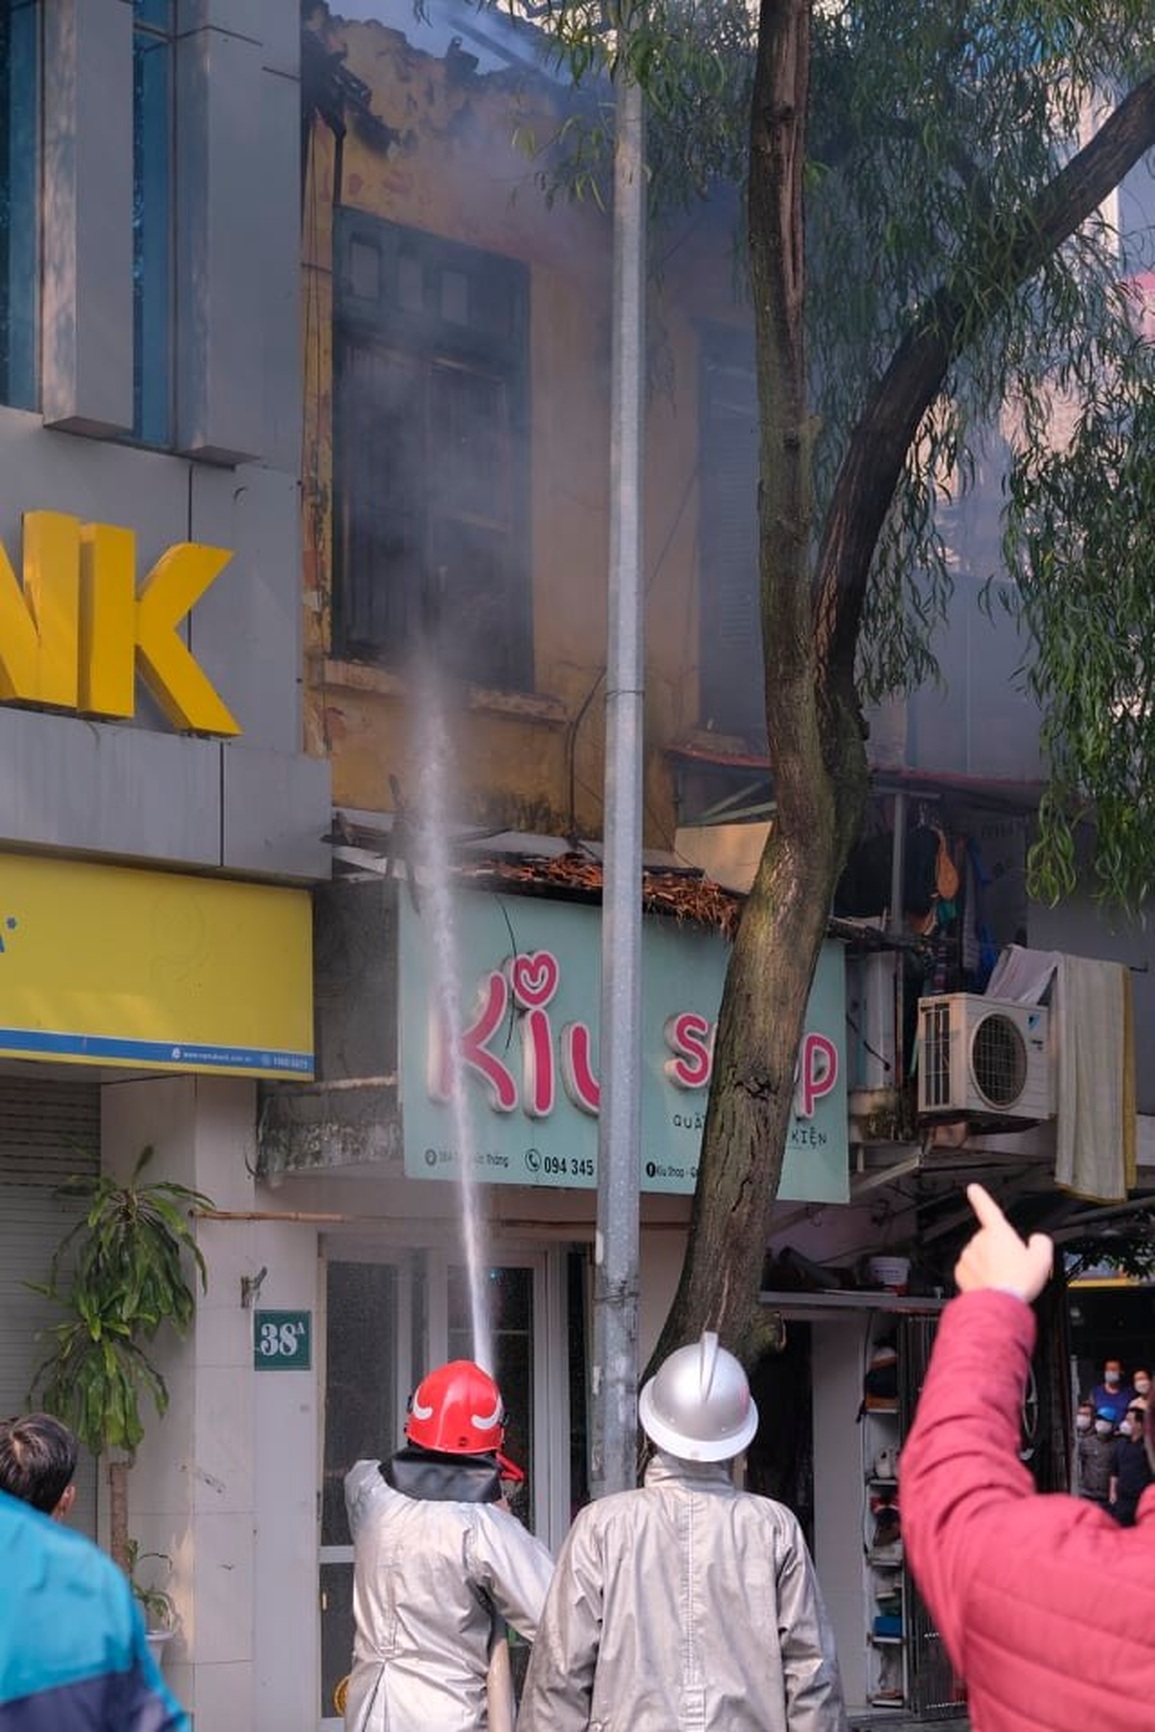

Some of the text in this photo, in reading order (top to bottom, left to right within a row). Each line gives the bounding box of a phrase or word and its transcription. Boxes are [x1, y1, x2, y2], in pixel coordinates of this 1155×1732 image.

[544, 1156, 595, 1177] 094 345
[261, 1322, 305, 1356] 38A
